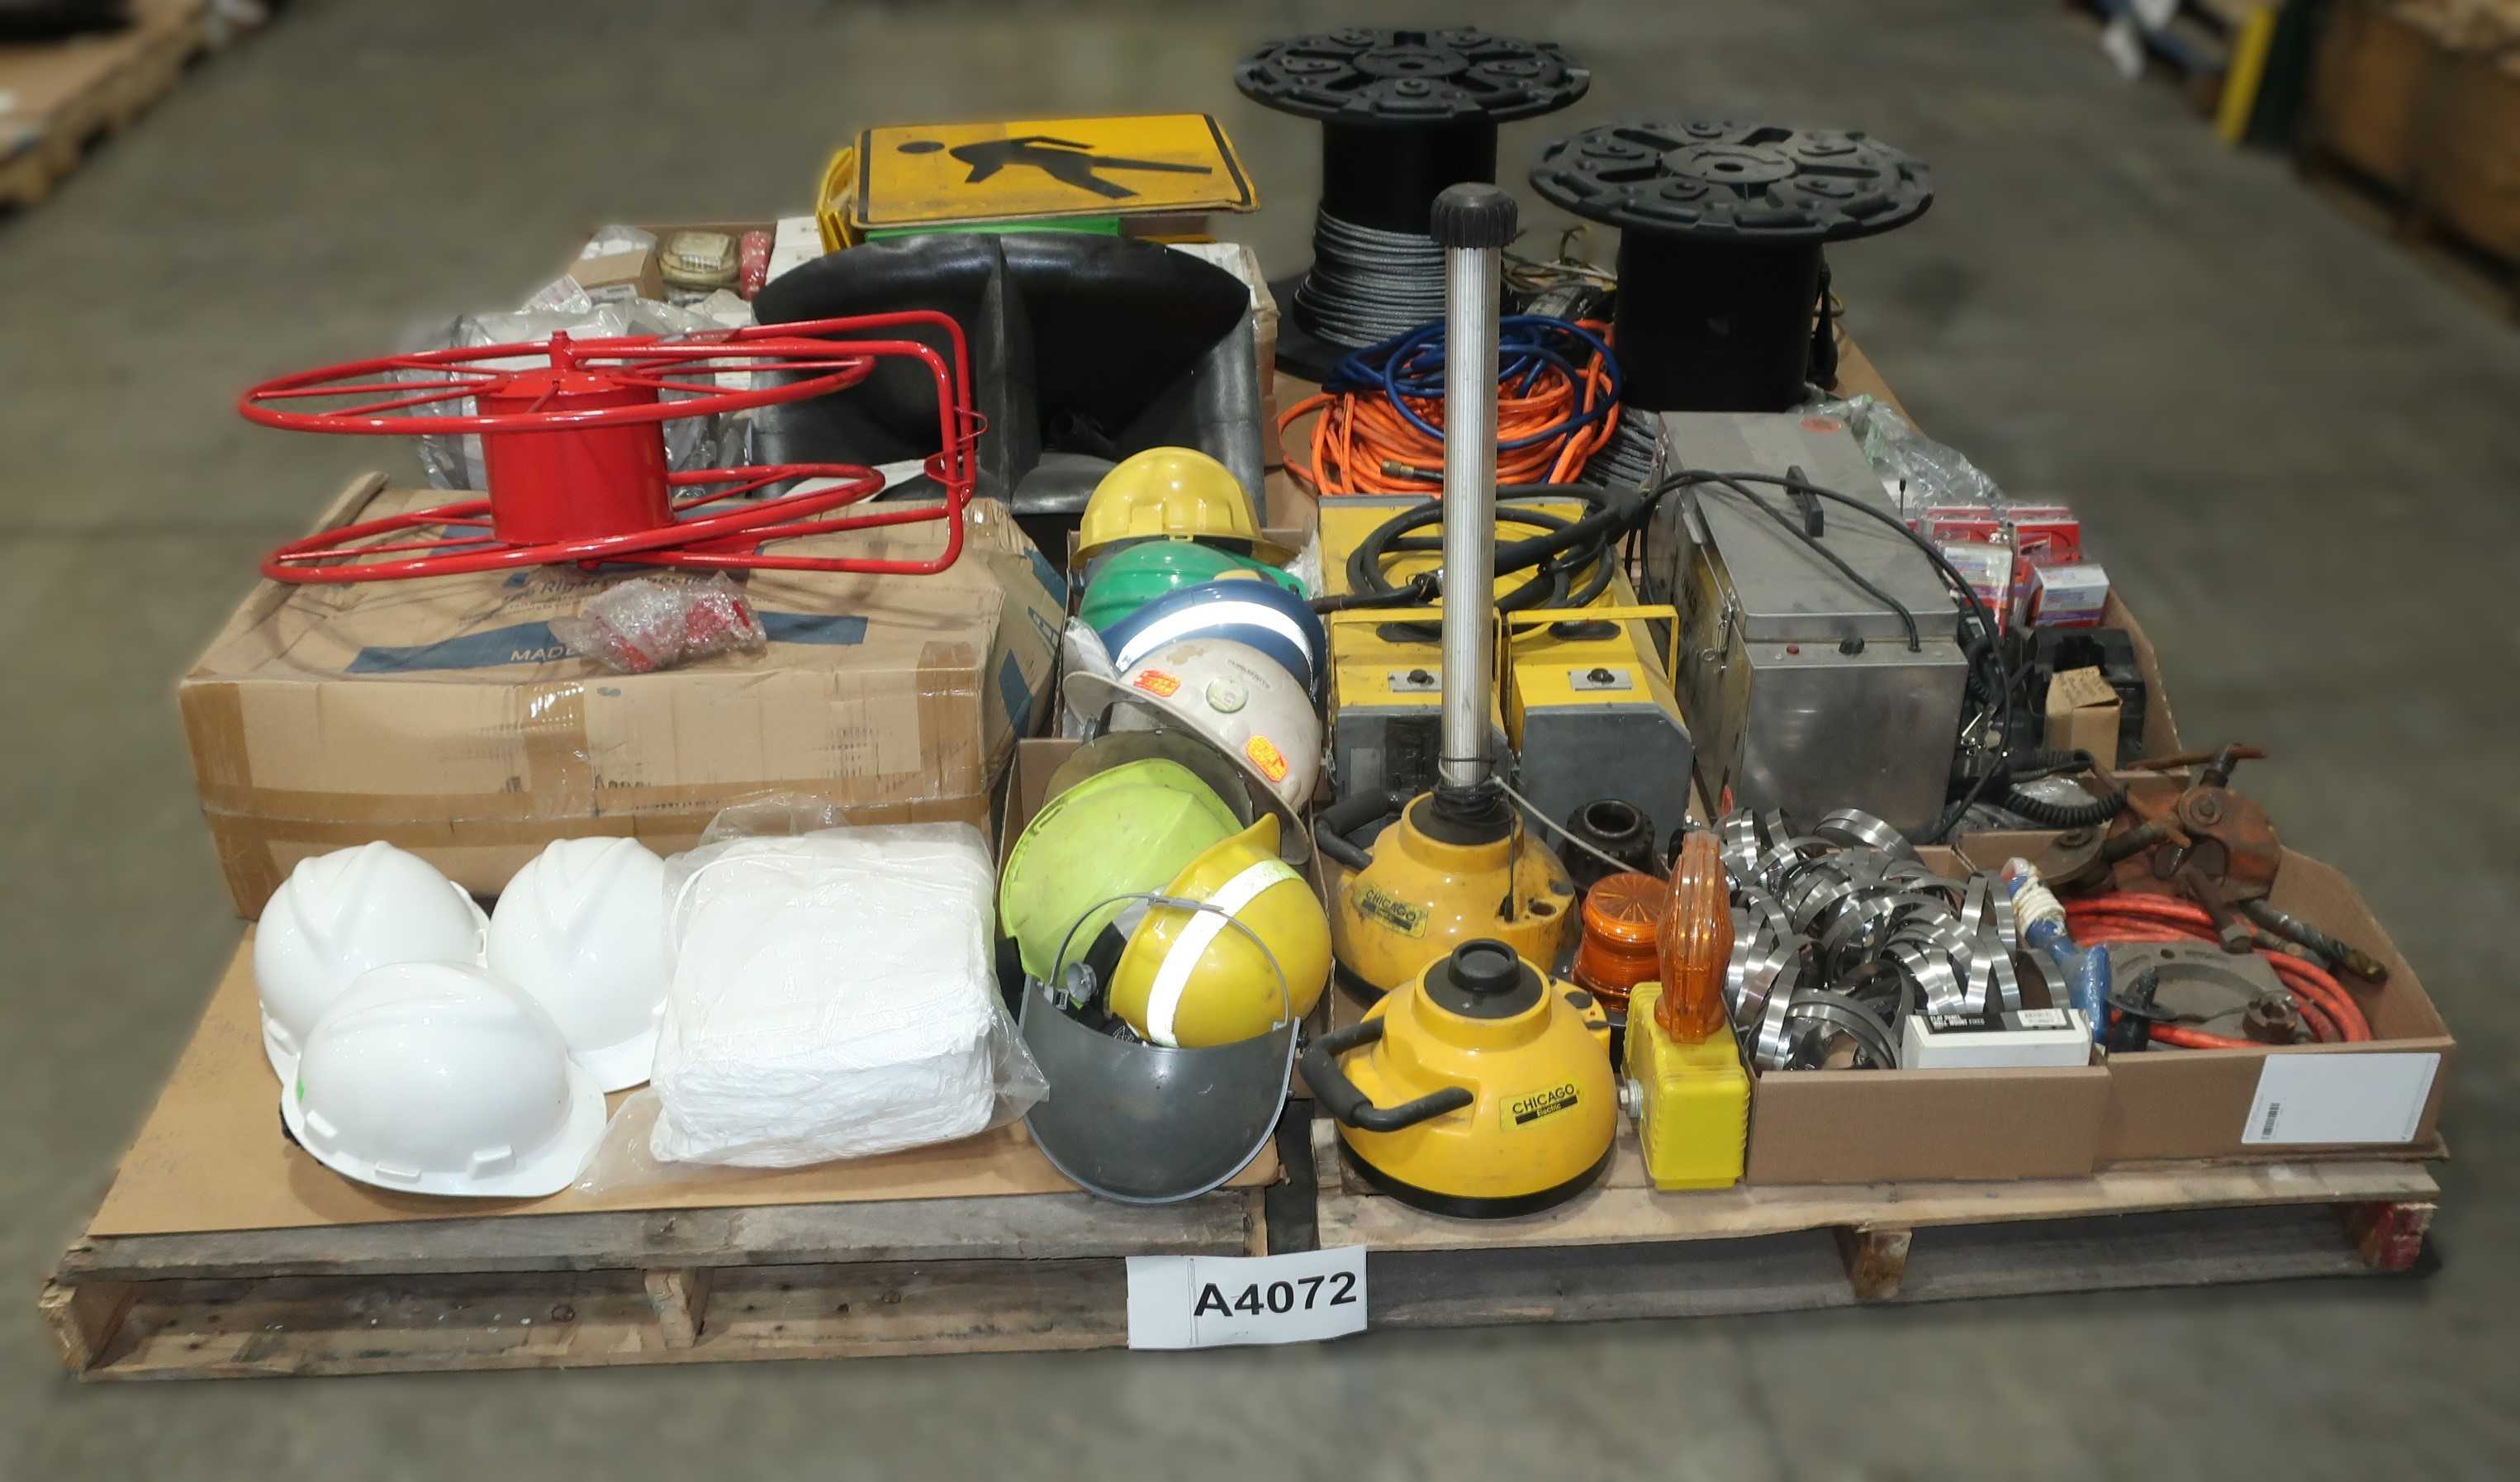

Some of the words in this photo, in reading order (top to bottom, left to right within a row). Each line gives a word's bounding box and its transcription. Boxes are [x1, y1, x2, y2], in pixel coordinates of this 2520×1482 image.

[1366, 889, 1417, 922] CHICAGO
[1968, 1017, 1985, 1025] FIXED
[1512, 1084, 1574, 1114] CHICAGO
[1536, 1103, 1562, 1117] Electric
[1194, 1271, 1357, 1318] A4072
